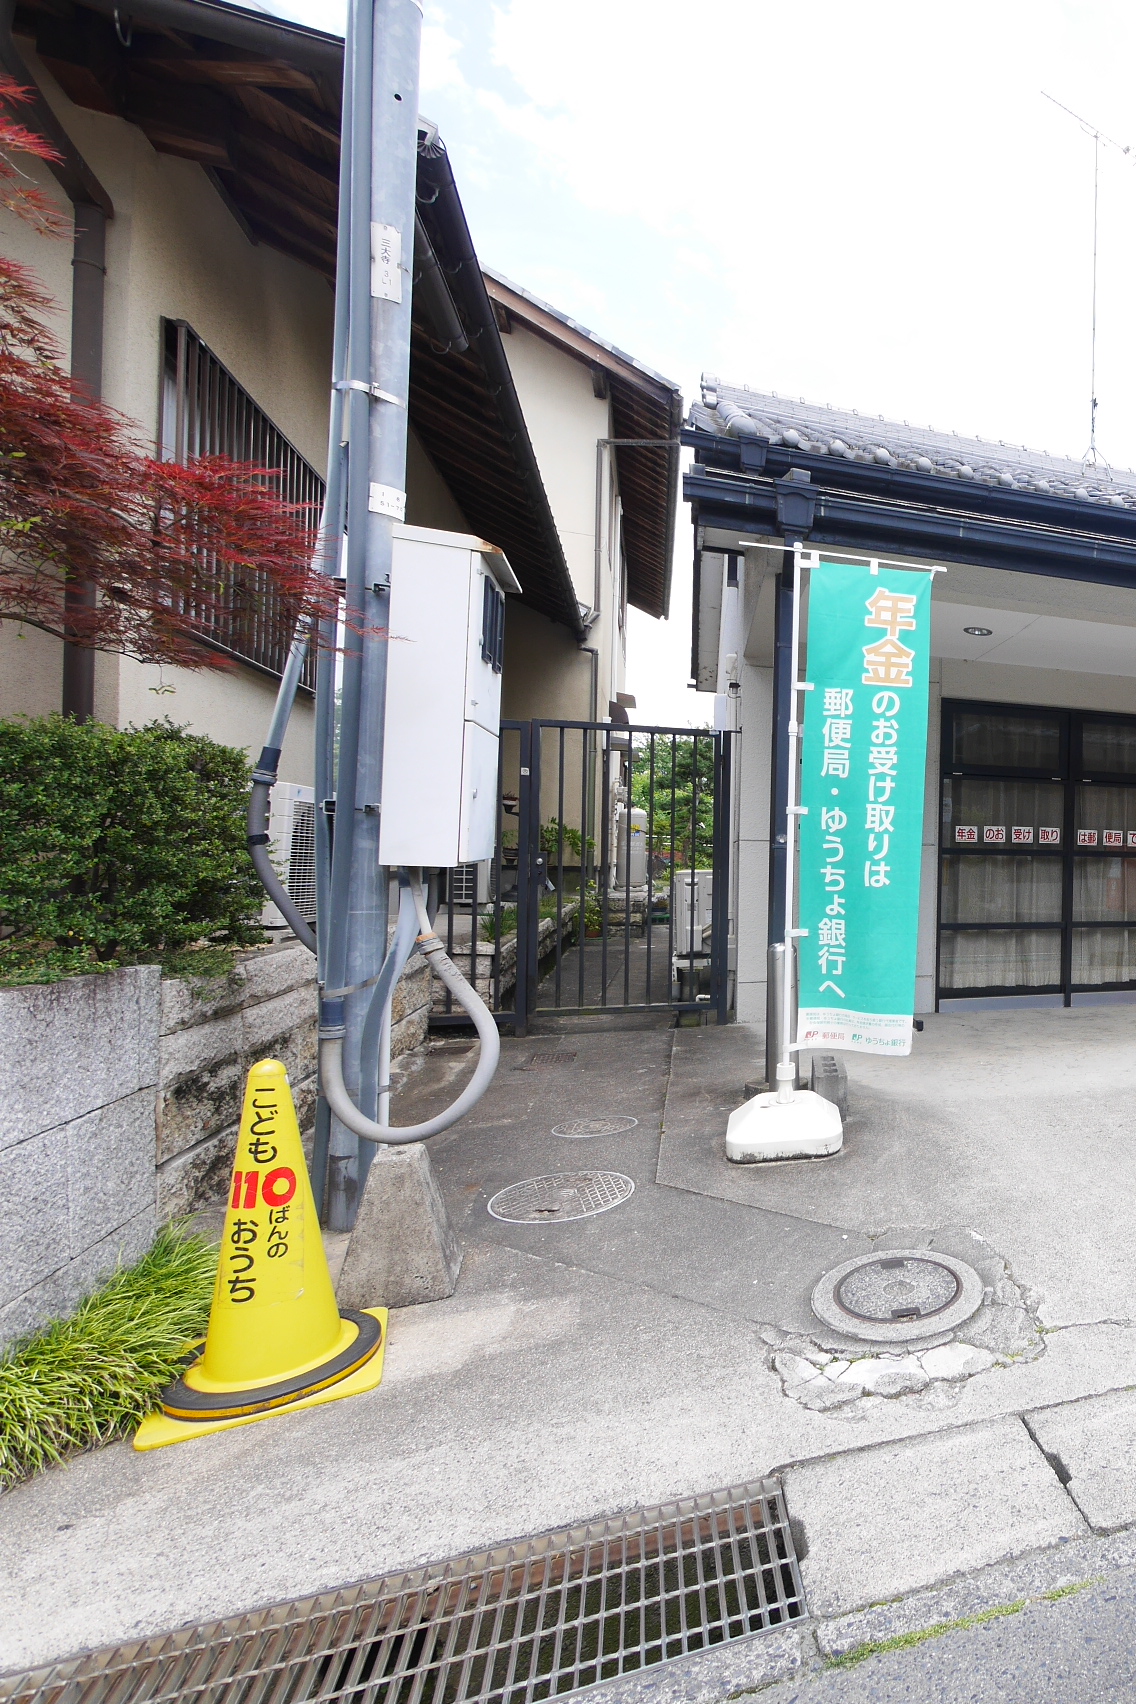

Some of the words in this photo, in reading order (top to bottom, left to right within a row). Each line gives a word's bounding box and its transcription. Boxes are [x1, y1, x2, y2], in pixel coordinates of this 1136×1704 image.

[861, 587, 917, 887] 年金のお受け取りは
[817, 687, 853, 999] 郵便局・ゆうちょ銀行へ
[822, 1032, 846, 1041] 郵便局
[865, 1036, 907, 1047] ゆうちょ銀行
[248, 1087, 278, 1164] こども
[231, 1166, 298, 1209] 110
[228, 1218, 260, 1303] おうち
[266, 1205, 291, 1259] ばんの
